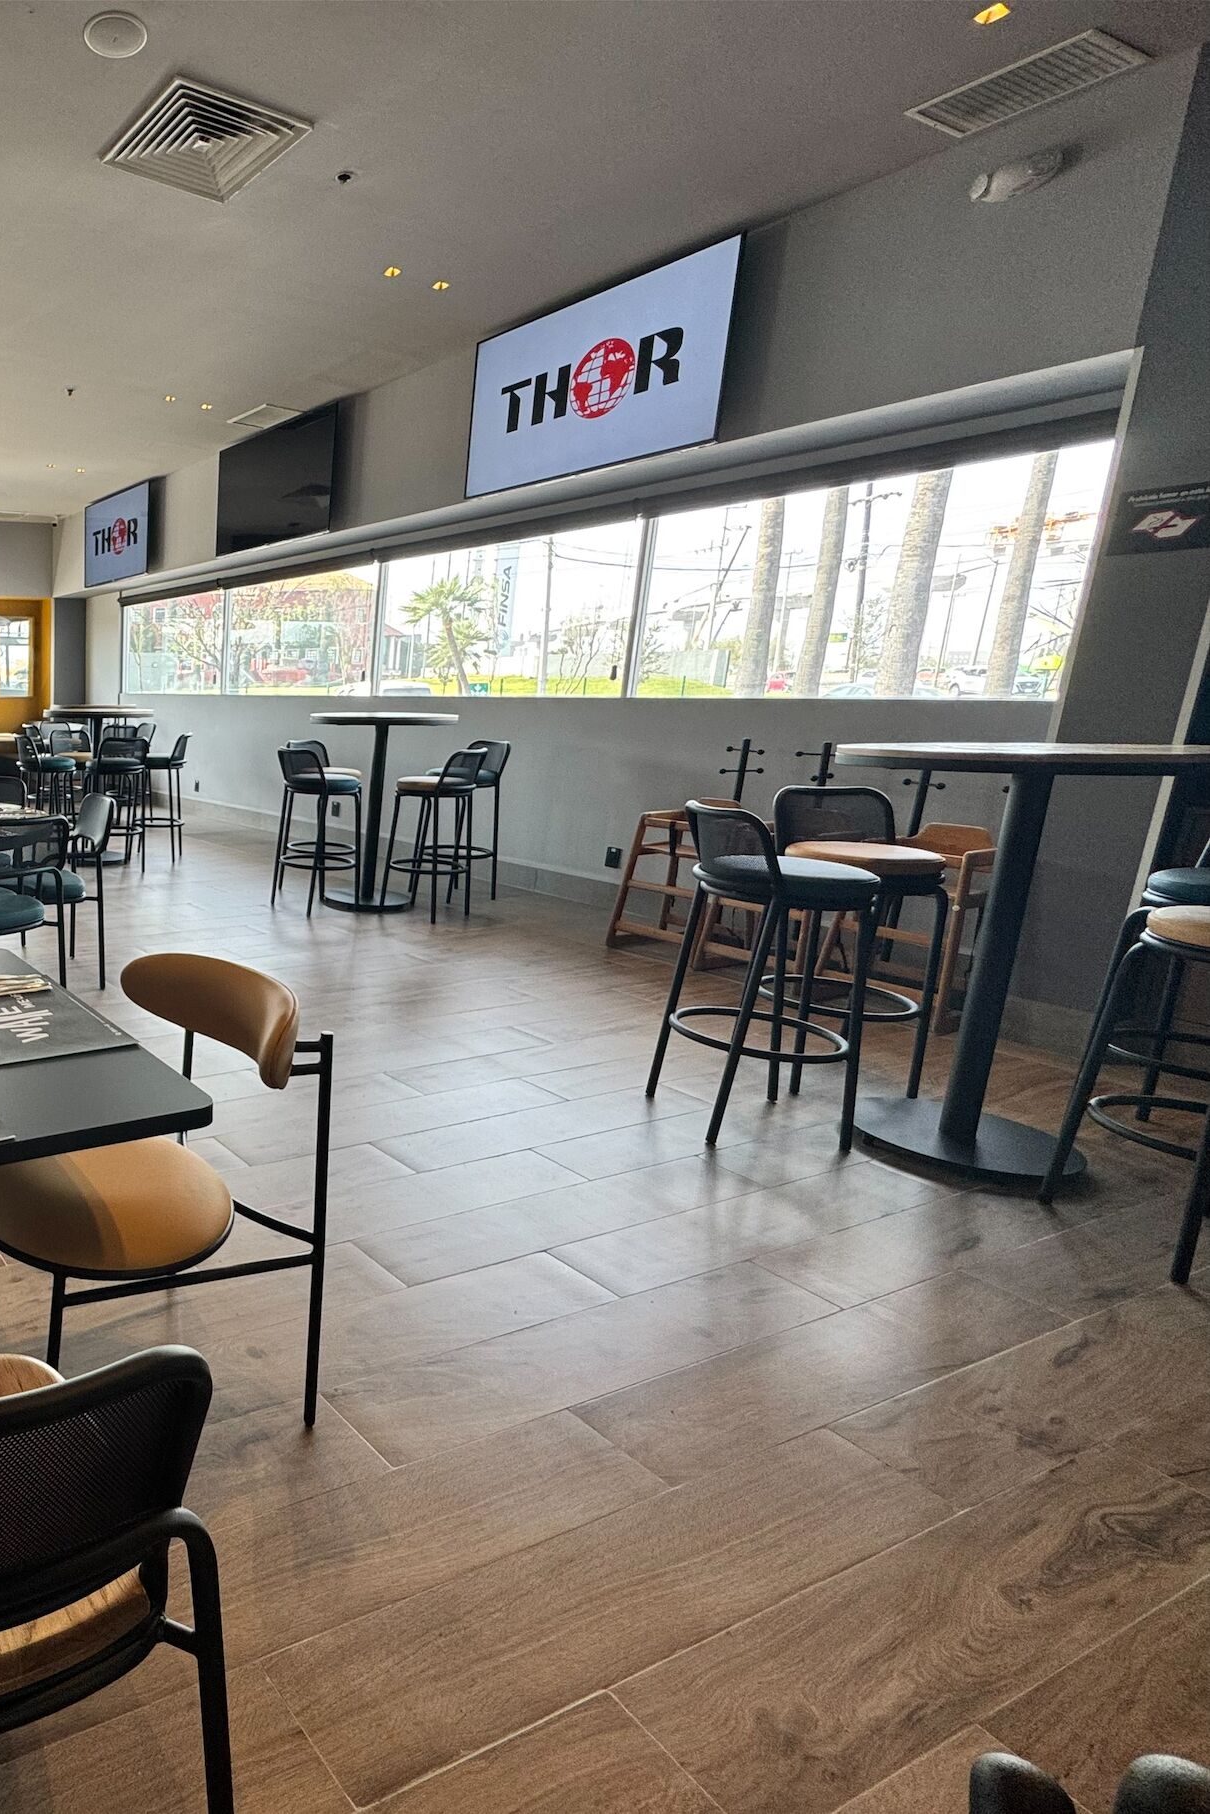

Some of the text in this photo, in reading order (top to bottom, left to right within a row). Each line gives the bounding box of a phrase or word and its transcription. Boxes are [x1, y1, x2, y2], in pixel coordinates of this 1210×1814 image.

[501, 327, 684, 433] THOR
[92, 517, 138, 556] THOR
[498, 565, 512, 627] FINSA
[16, 998, 36, 1008] ME
